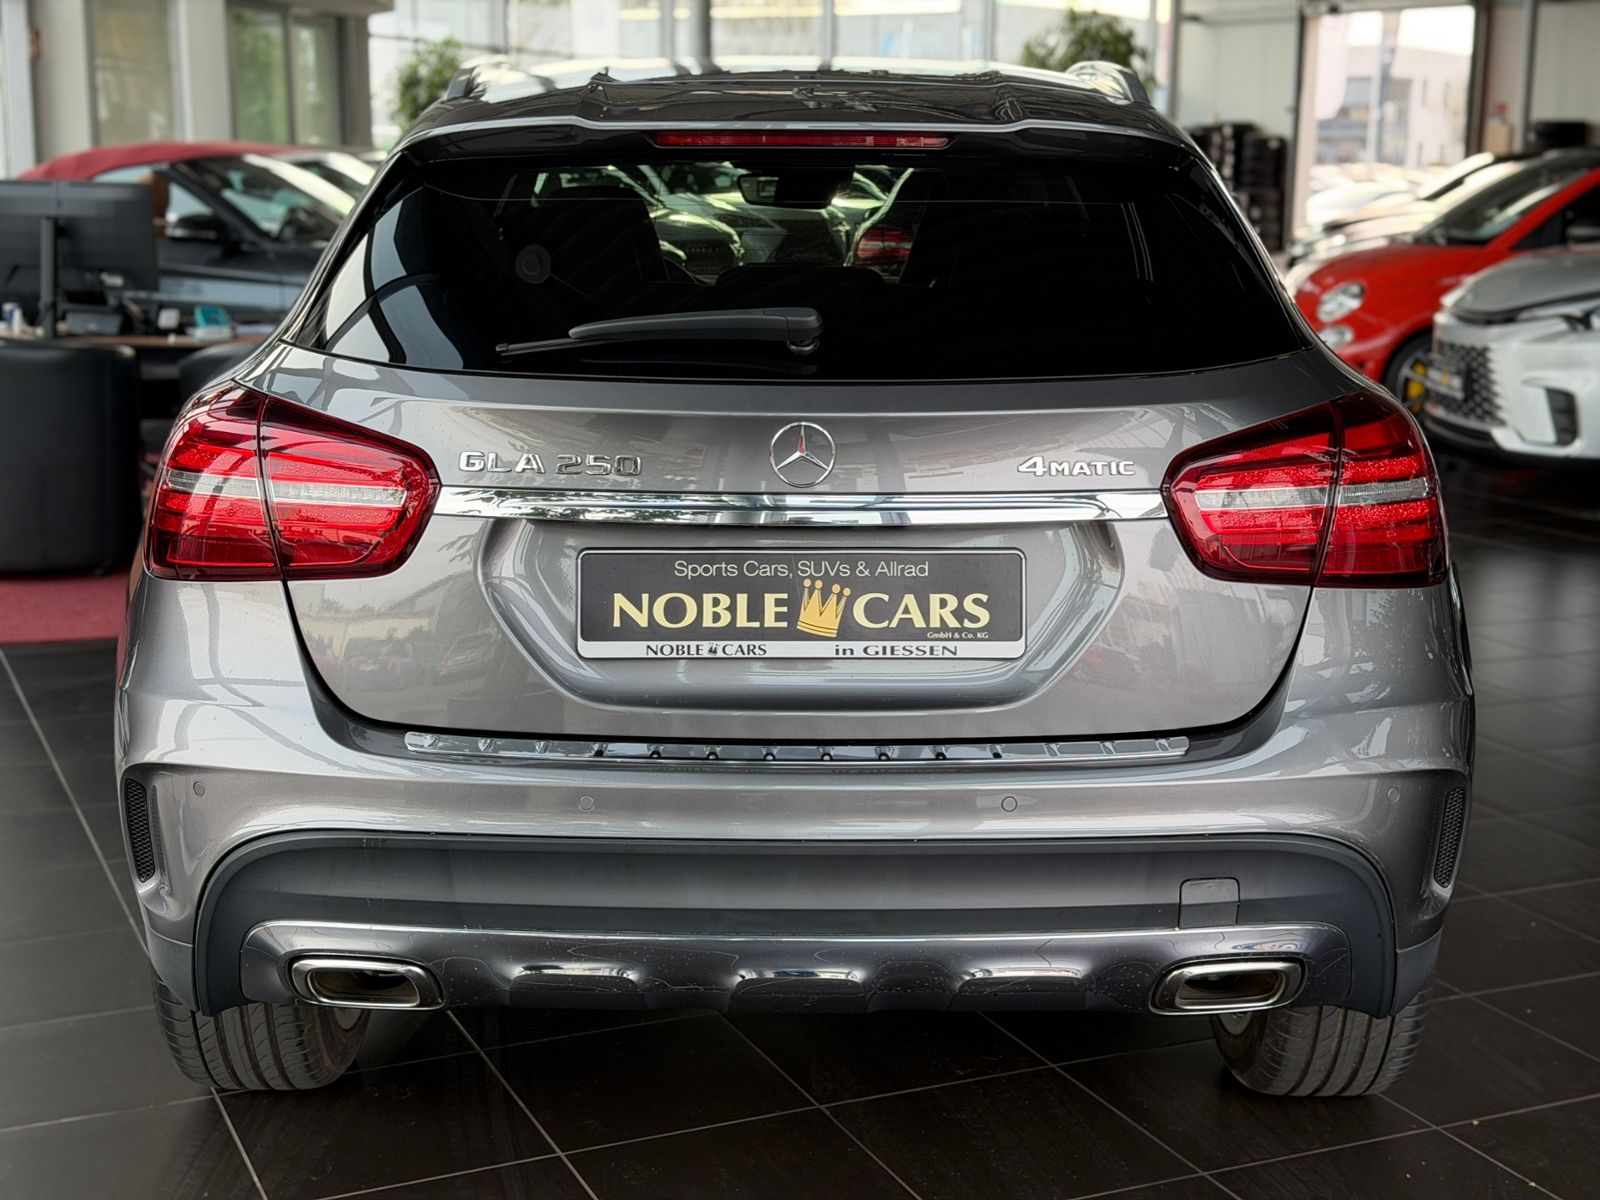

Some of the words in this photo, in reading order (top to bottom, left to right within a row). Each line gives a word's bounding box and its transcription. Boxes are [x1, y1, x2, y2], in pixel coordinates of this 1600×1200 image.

[459, 451, 546, 473] GLA
[556, 454, 642, 476] 250
[1017, 456, 1136, 477] 4MATIC
[674, 560, 738, 579] Sports
[743, 560, 793, 578] Cars,
[797, 560, 850, 576] SUVs
[855, 561, 870, 577] &
[875, 560, 929, 577] Allrad
[612, 593, 788, 628] NOBLE
[852, 593, 990, 628] CARS
[927, 631, 951, 640] GmbH
[962, 631, 975, 640] Co.
[977, 631, 989, 640] KG
[646, 644, 703, 656] NOBLE
[722, 644, 767, 656] CARS
[834, 645, 855, 656] in
[862, 645, 958, 656] GIESSEN
